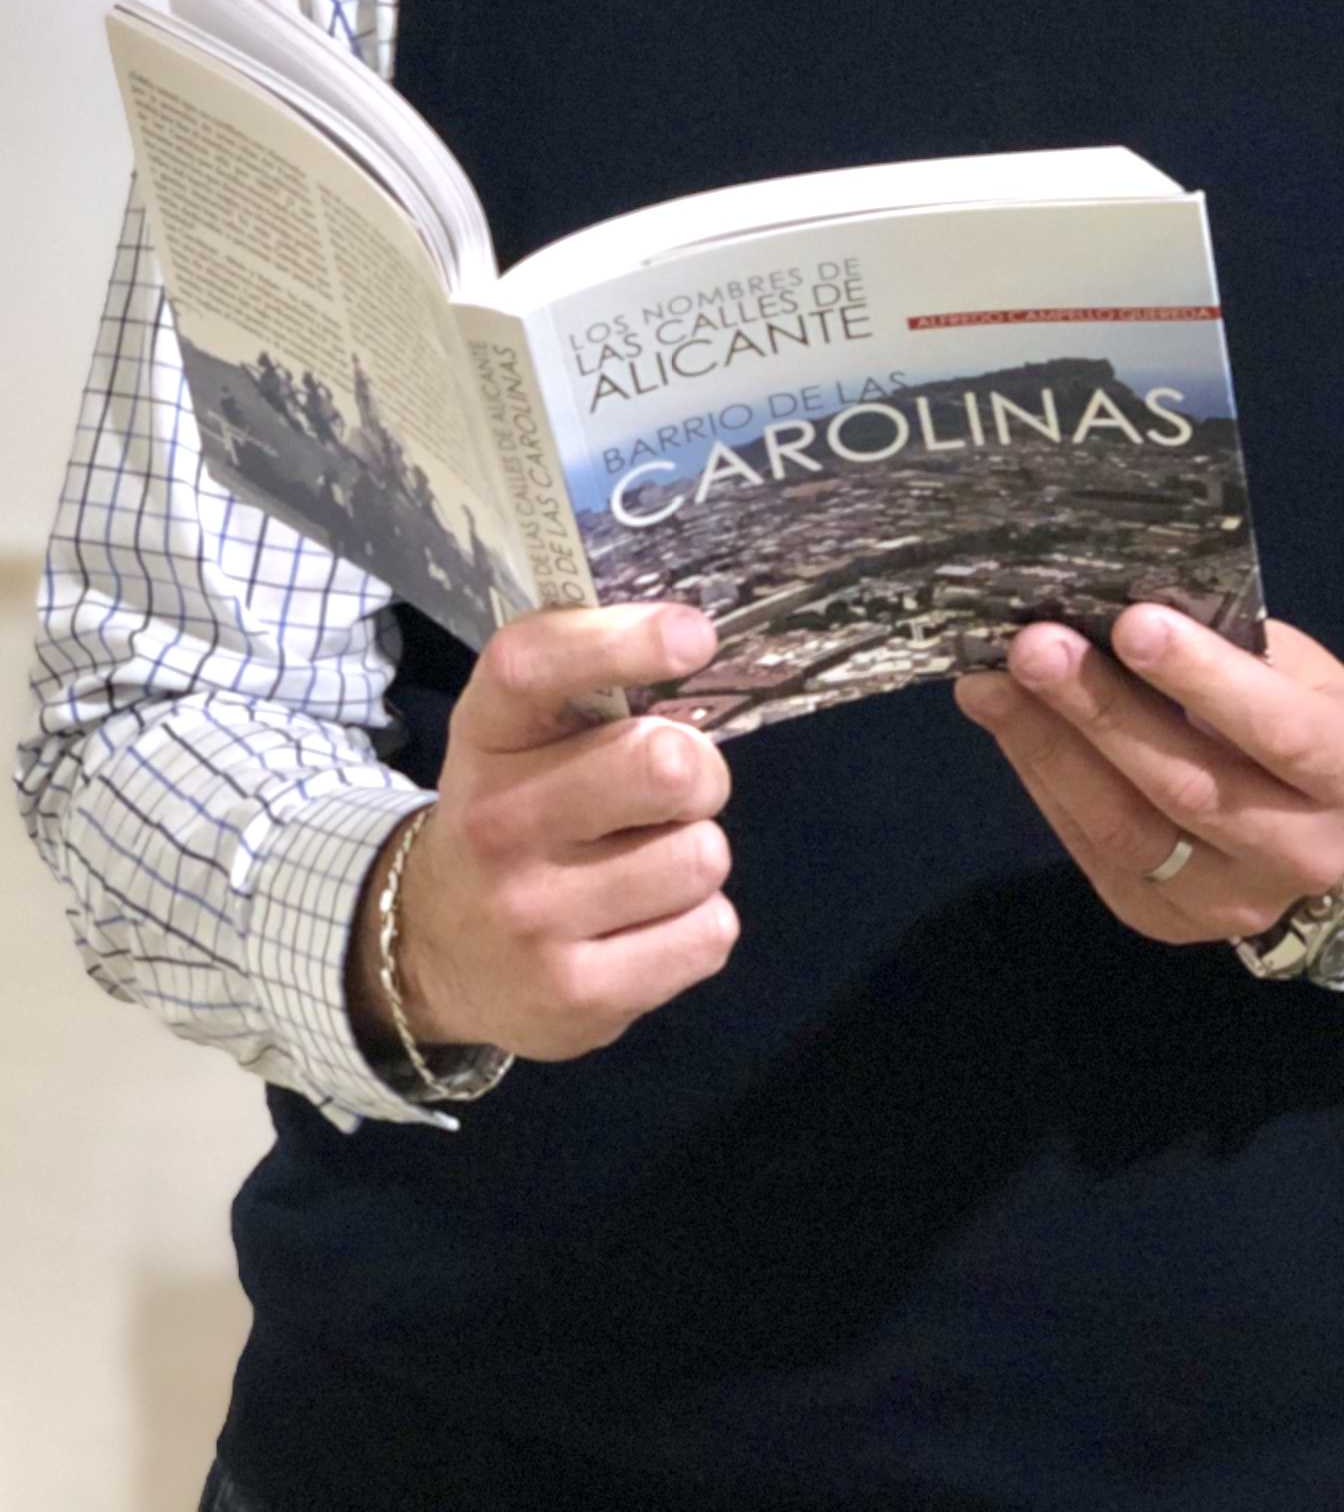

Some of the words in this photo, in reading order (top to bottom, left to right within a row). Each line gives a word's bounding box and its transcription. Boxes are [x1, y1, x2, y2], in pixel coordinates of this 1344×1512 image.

[569, 315, 630, 351] LOS
[642, 268, 804, 326] NOMBRES
[817, 258, 861, 282] DE
[576, 333, 643, 376] LAS
[656, 289, 798, 345] CALLES
[812, 278, 867, 308] DE
[589, 303, 874, 414] ALICANTE
[491, 342, 553, 489] CAROLINAS
[603, 404, 753, 474] BARRIO
[768, 386, 824, 418] DE
[836, 371, 907, 405] LAS
[610, 386, 1193, 529] CAROLINAS
[535, 494, 567, 540] LAS
[548, 541, 577, 577] DE
